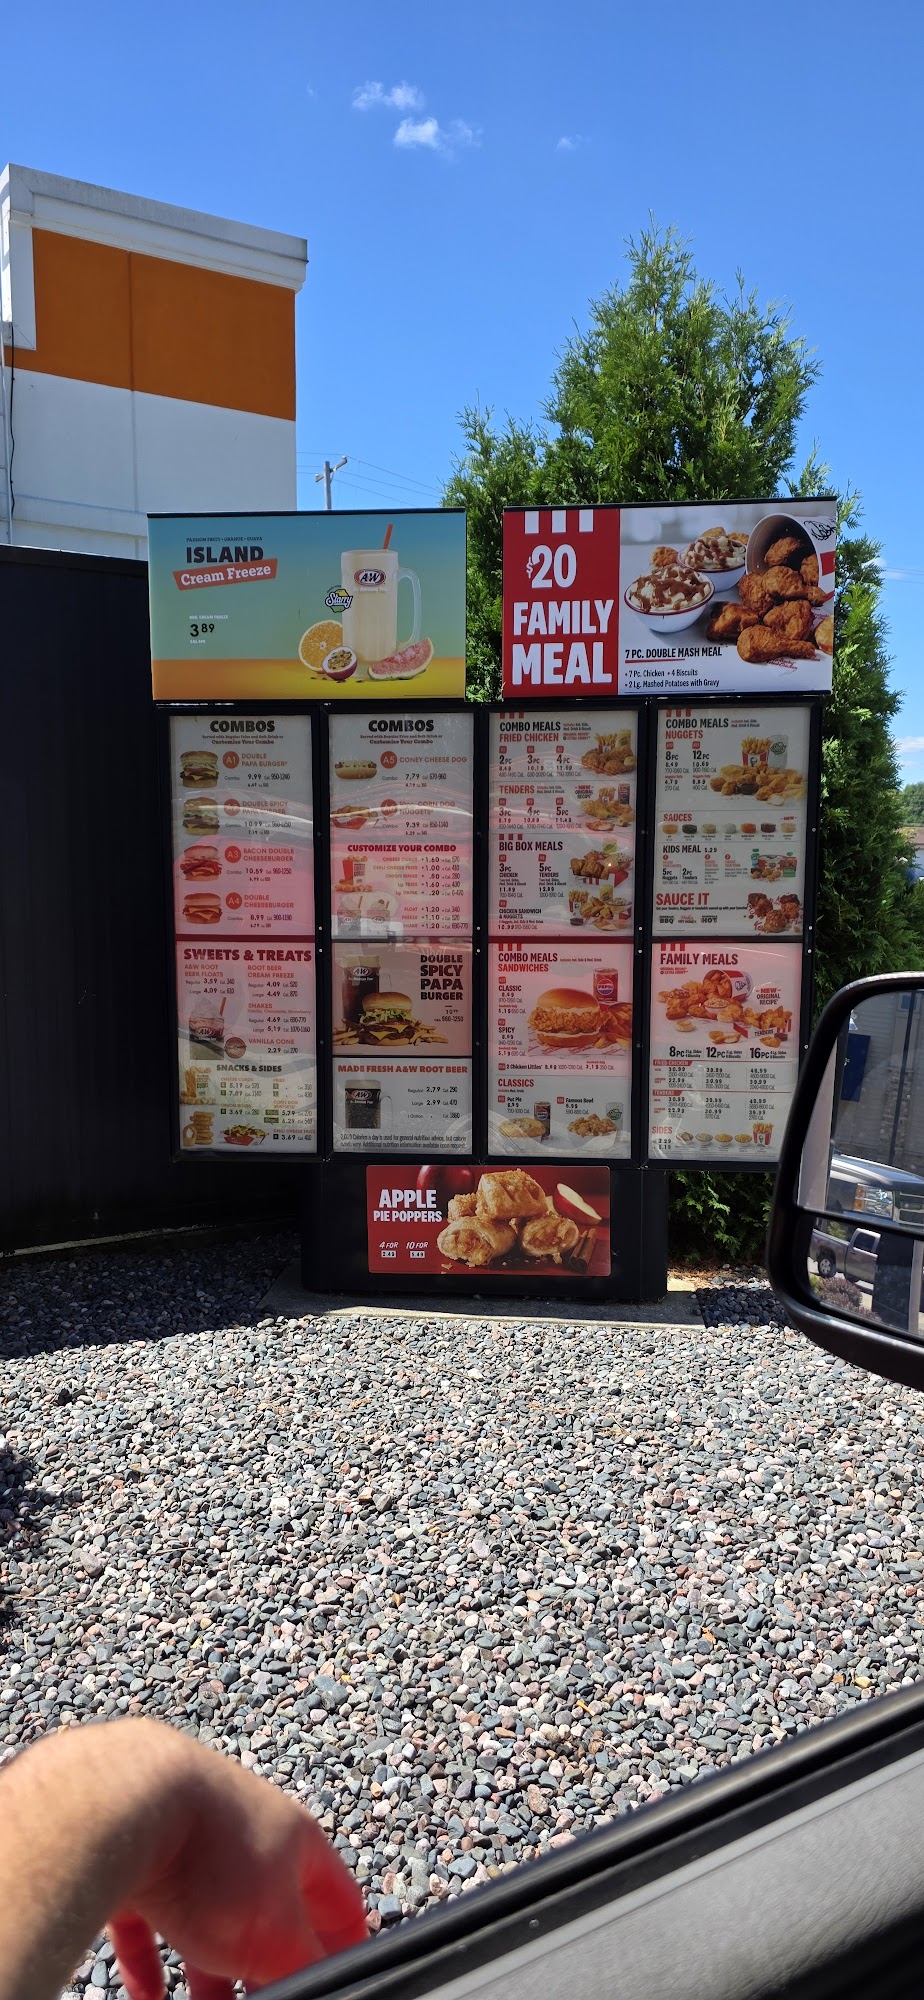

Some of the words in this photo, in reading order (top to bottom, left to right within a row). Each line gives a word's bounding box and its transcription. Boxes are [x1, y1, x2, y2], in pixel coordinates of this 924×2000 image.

[187, 546, 263, 563] ISLAND
[181, 571, 224, 585] Cream
[227, 566, 271, 579] Freeze
[513, 600, 614, 635] FAMILY
[625, 650, 630, 658] 7
[632, 650, 644, 658] PC.
[646, 649, 676, 658] DOUBLE
[678, 648, 700, 657] MASH
[702, 647, 722, 656] MEAL
[512, 642, 612, 685] MEAL
[703, 679, 719, 687] Gravy
[210, 720, 275, 732] COMBOS
[369, 720, 434, 732] COMBOS
[500, 722, 530, 732] COMBO
[533, 722, 561, 731] MEALS
[666, 719, 697, 728] COMBO
[700, 718, 728, 728] MEALS
[500, 733, 522, 742] FRIED
[524, 733, 558, 742] CHICKEN
[666, 730, 703, 739] NUGGETS
[500, 785, 534, 794] TENDERS
[500, 842, 513, 851] BIG
[516, 842, 533, 851] BOX
[535, 842, 563, 850] MEALS
[682, 845, 701, 853] MEAL
[656, 893, 694, 905] SAUCE
[698, 893, 709, 905] IT
[184, 949, 239, 960] SWEETS
[244, 950, 253, 960] &
[257, 950, 311, 961] TREATS
[421, 955, 462, 963] DOUBLE
[498, 953, 528, 962] COMBO
[531, 953, 558, 962] MEALS
[660, 954, 700, 964] FAMILY
[702, 954, 738, 964] MEALS
[420, 965, 463, 976] SPICY
[498, 964, 548, 972] SANDWICHES
[421, 979, 463, 990] PAPA
[421, 992, 463, 1000] BURGER
[498, 1079, 534, 1087] CLASSICS
[652, 1126, 672, 1134] SIDES
[379, 1189, 437, 1208] APPLE
[373, 1210, 391, 1221] PIE
[392, 1211, 442, 1222] POPPERS
[379, 1241, 385, 1249] 4
